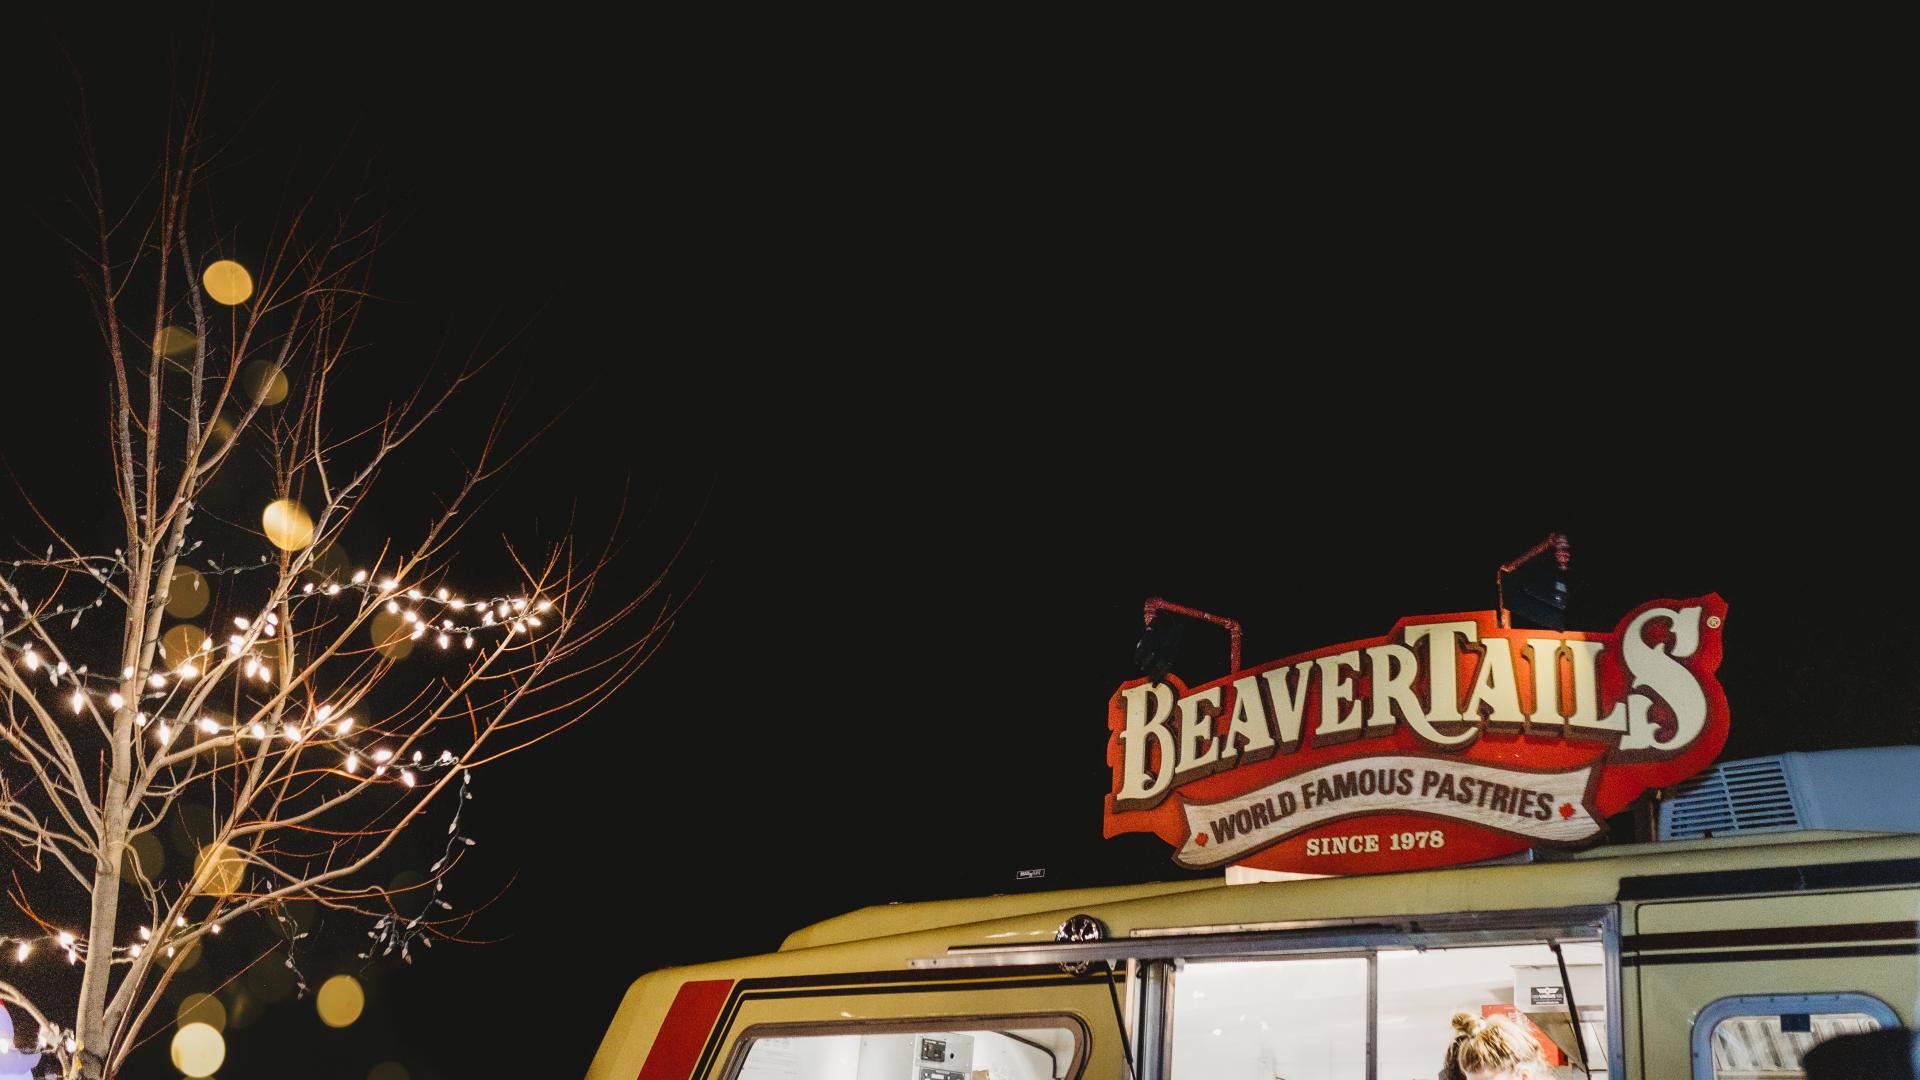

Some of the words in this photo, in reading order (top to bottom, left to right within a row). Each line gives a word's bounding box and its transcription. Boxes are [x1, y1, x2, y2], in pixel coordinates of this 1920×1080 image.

[1209, 792, 1299, 844] WORLD
[1300, 769, 1413, 805] FAMOUS
[1421, 769, 1555, 822] PASTRIES
[1305, 833, 1380, 856] SINCE
[1389, 830, 1446, 851] 1978
